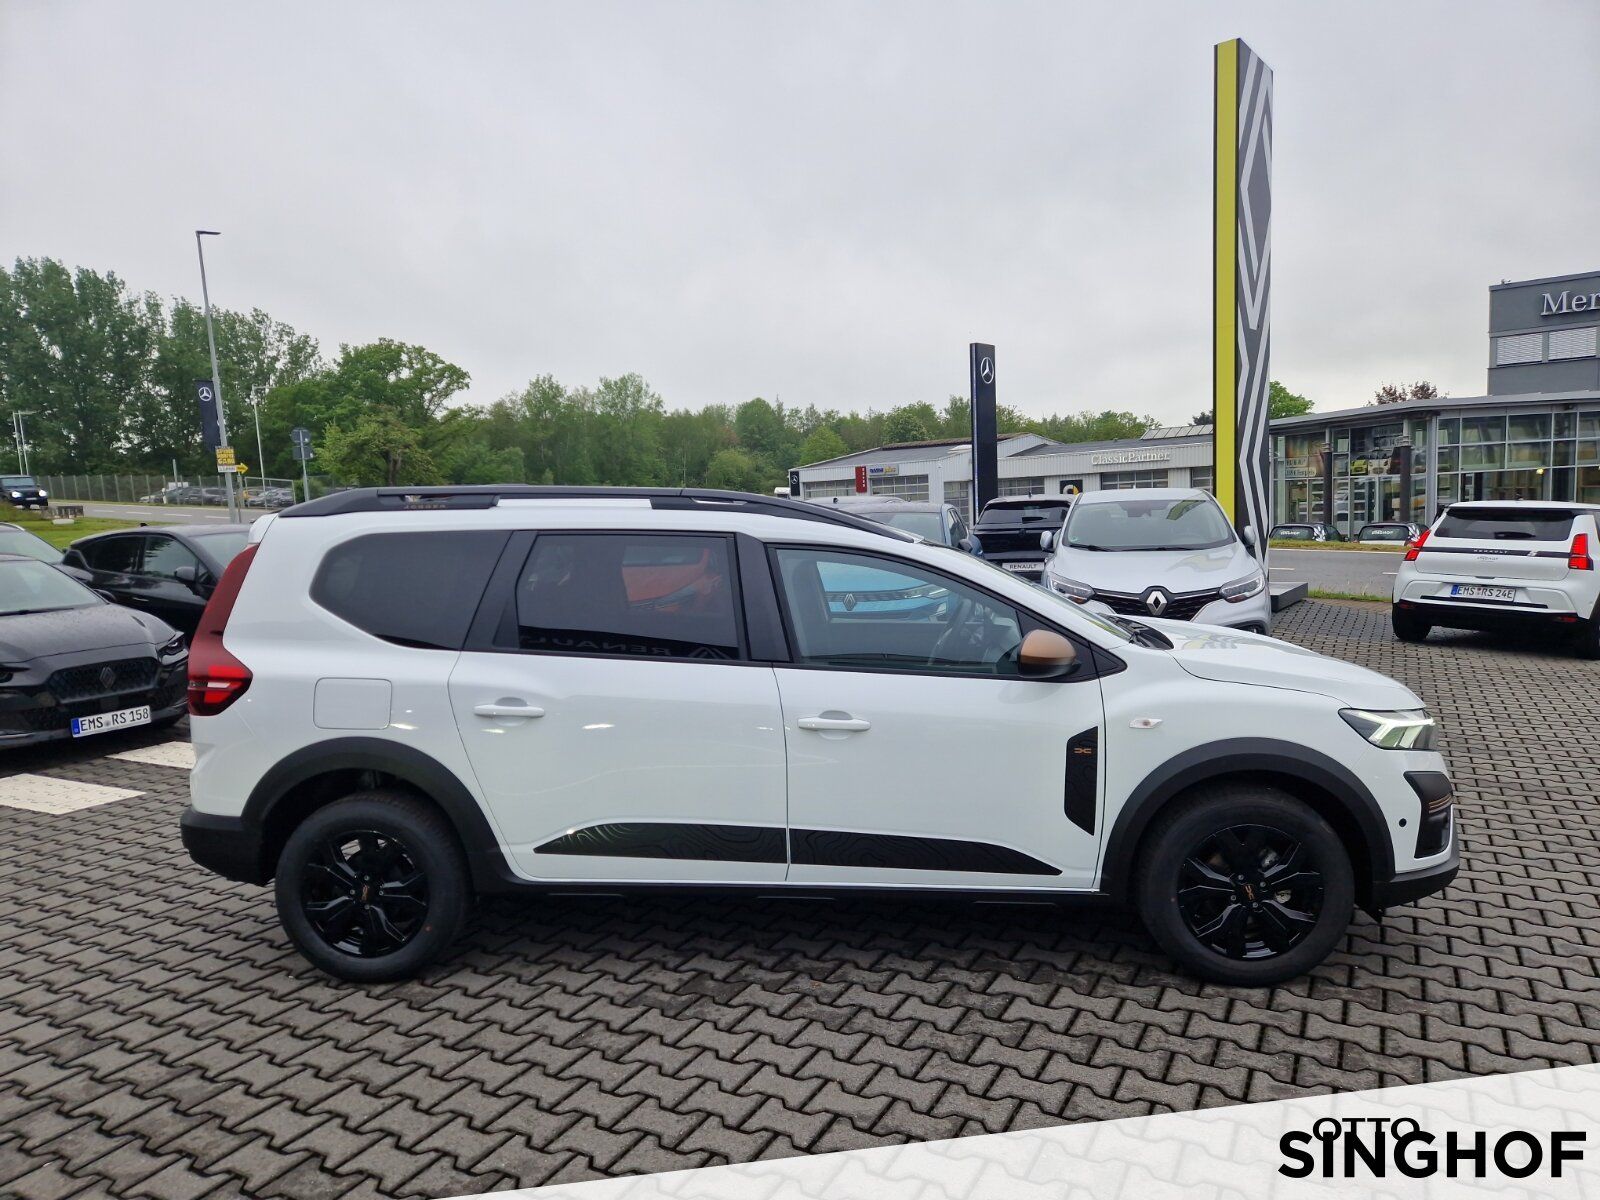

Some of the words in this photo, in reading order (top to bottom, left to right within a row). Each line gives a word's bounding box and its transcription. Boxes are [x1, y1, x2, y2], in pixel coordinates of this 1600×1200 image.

[1541, 291, 1600, 316] Mer
[1457, 586, 1476, 596] EMS
[1481, 587, 1494, 597] RS
[1495, 589, 1514, 599] 24E
[80, 716, 104, 732] EMS
[111, 712, 127, 726] RS
[128, 707, 149, 723] 158
